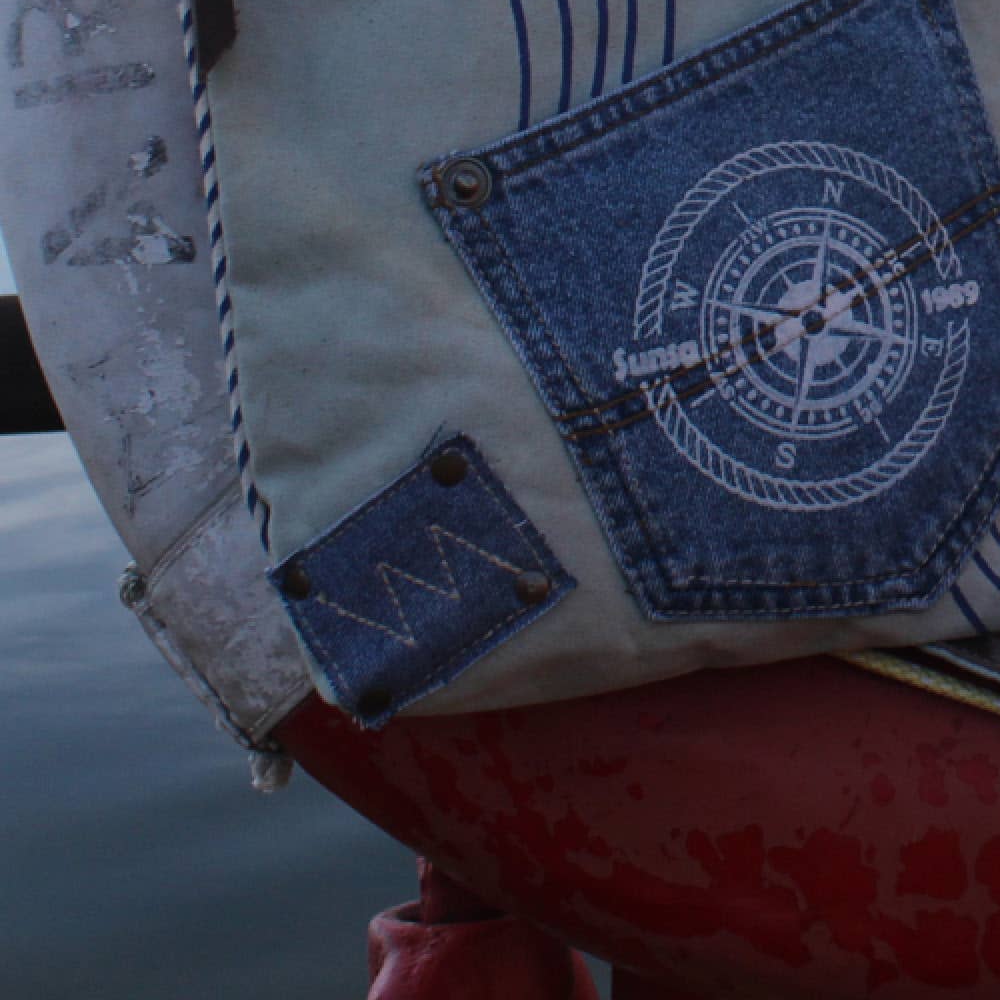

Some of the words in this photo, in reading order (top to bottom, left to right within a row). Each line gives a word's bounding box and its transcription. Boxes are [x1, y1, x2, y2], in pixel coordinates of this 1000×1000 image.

[823, 179, 845, 203] N
[612, 340, 702, 383] Sunsa
[775, 443, 797, 469] S
